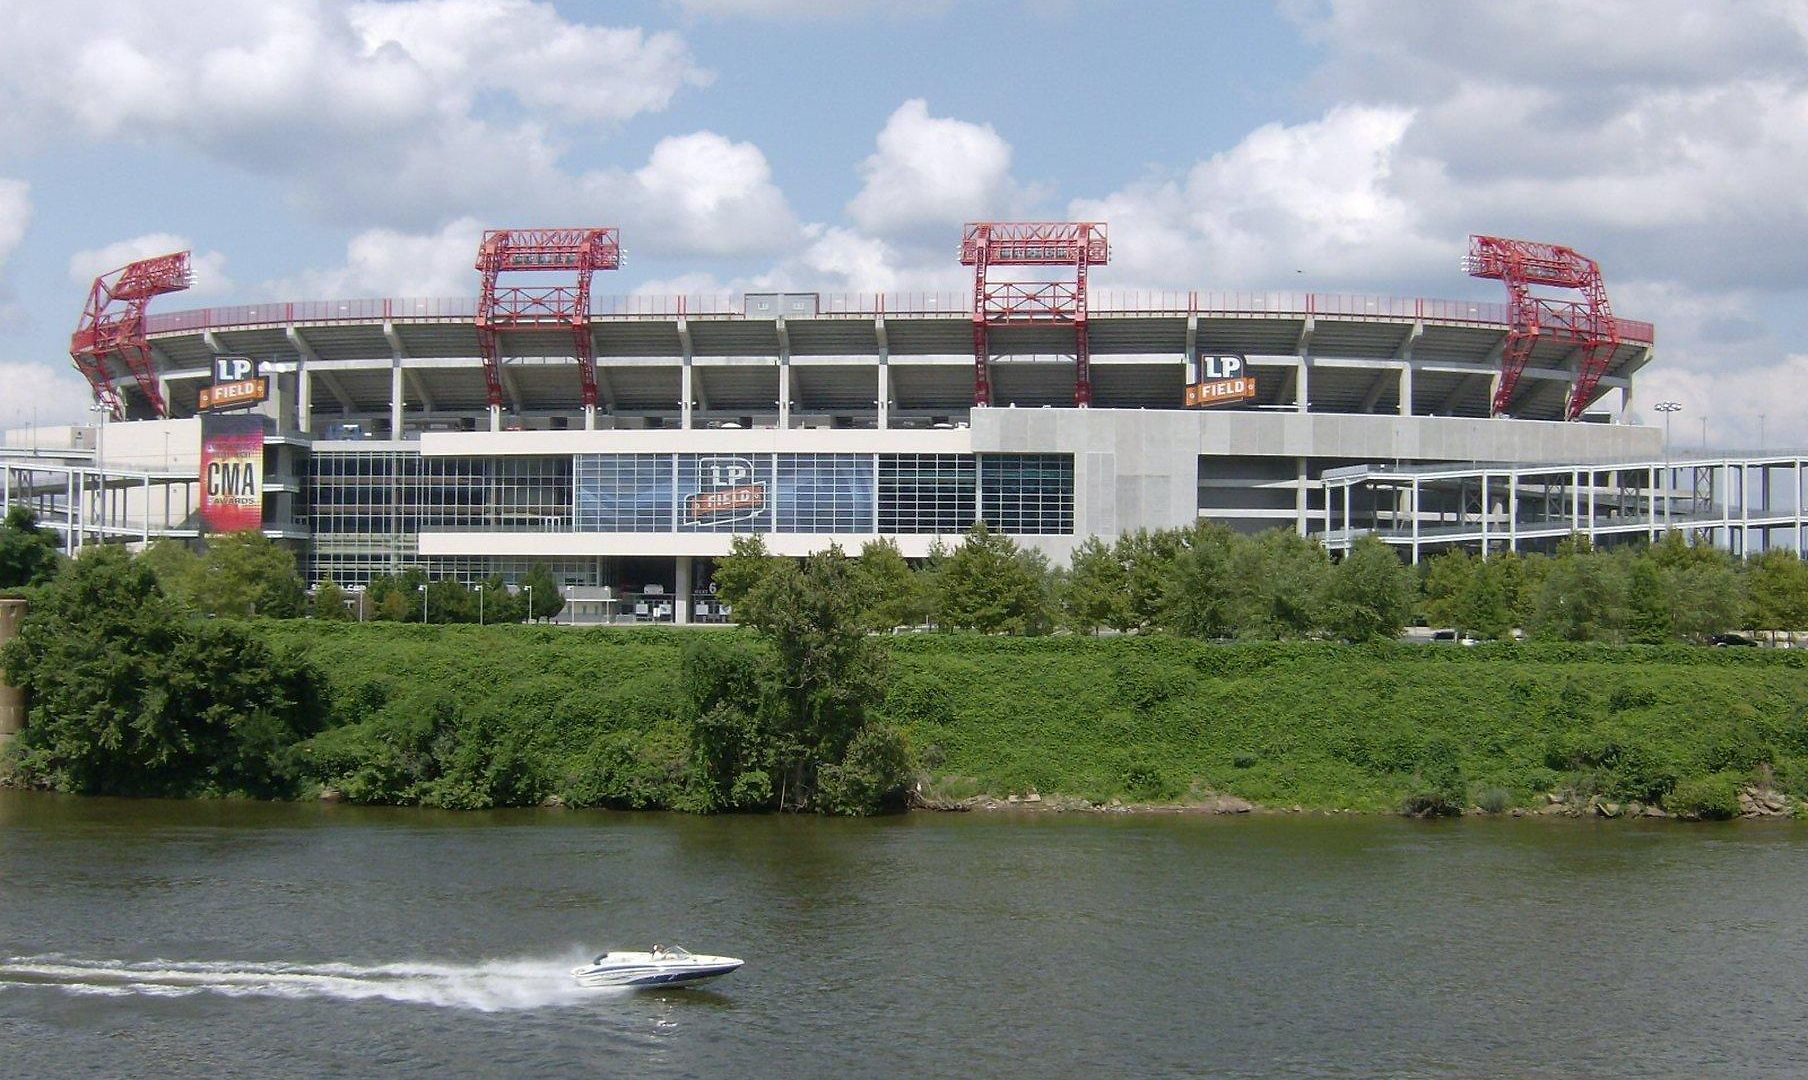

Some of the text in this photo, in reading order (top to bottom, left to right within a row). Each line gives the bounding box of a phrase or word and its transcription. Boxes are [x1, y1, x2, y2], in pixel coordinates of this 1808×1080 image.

[217, 360, 251, 380] LP
[1204, 357, 1241, 377] LP
[214, 383, 255, 399] FIELD
[1202, 381, 1245, 398] FIELD
[207, 462, 255, 496] CMA
[710, 466, 747, 486] LP
[214, 497, 255, 505] AWARDS
[707, 489, 750, 507] FIELD
[709, 582, 717, 594] 6
